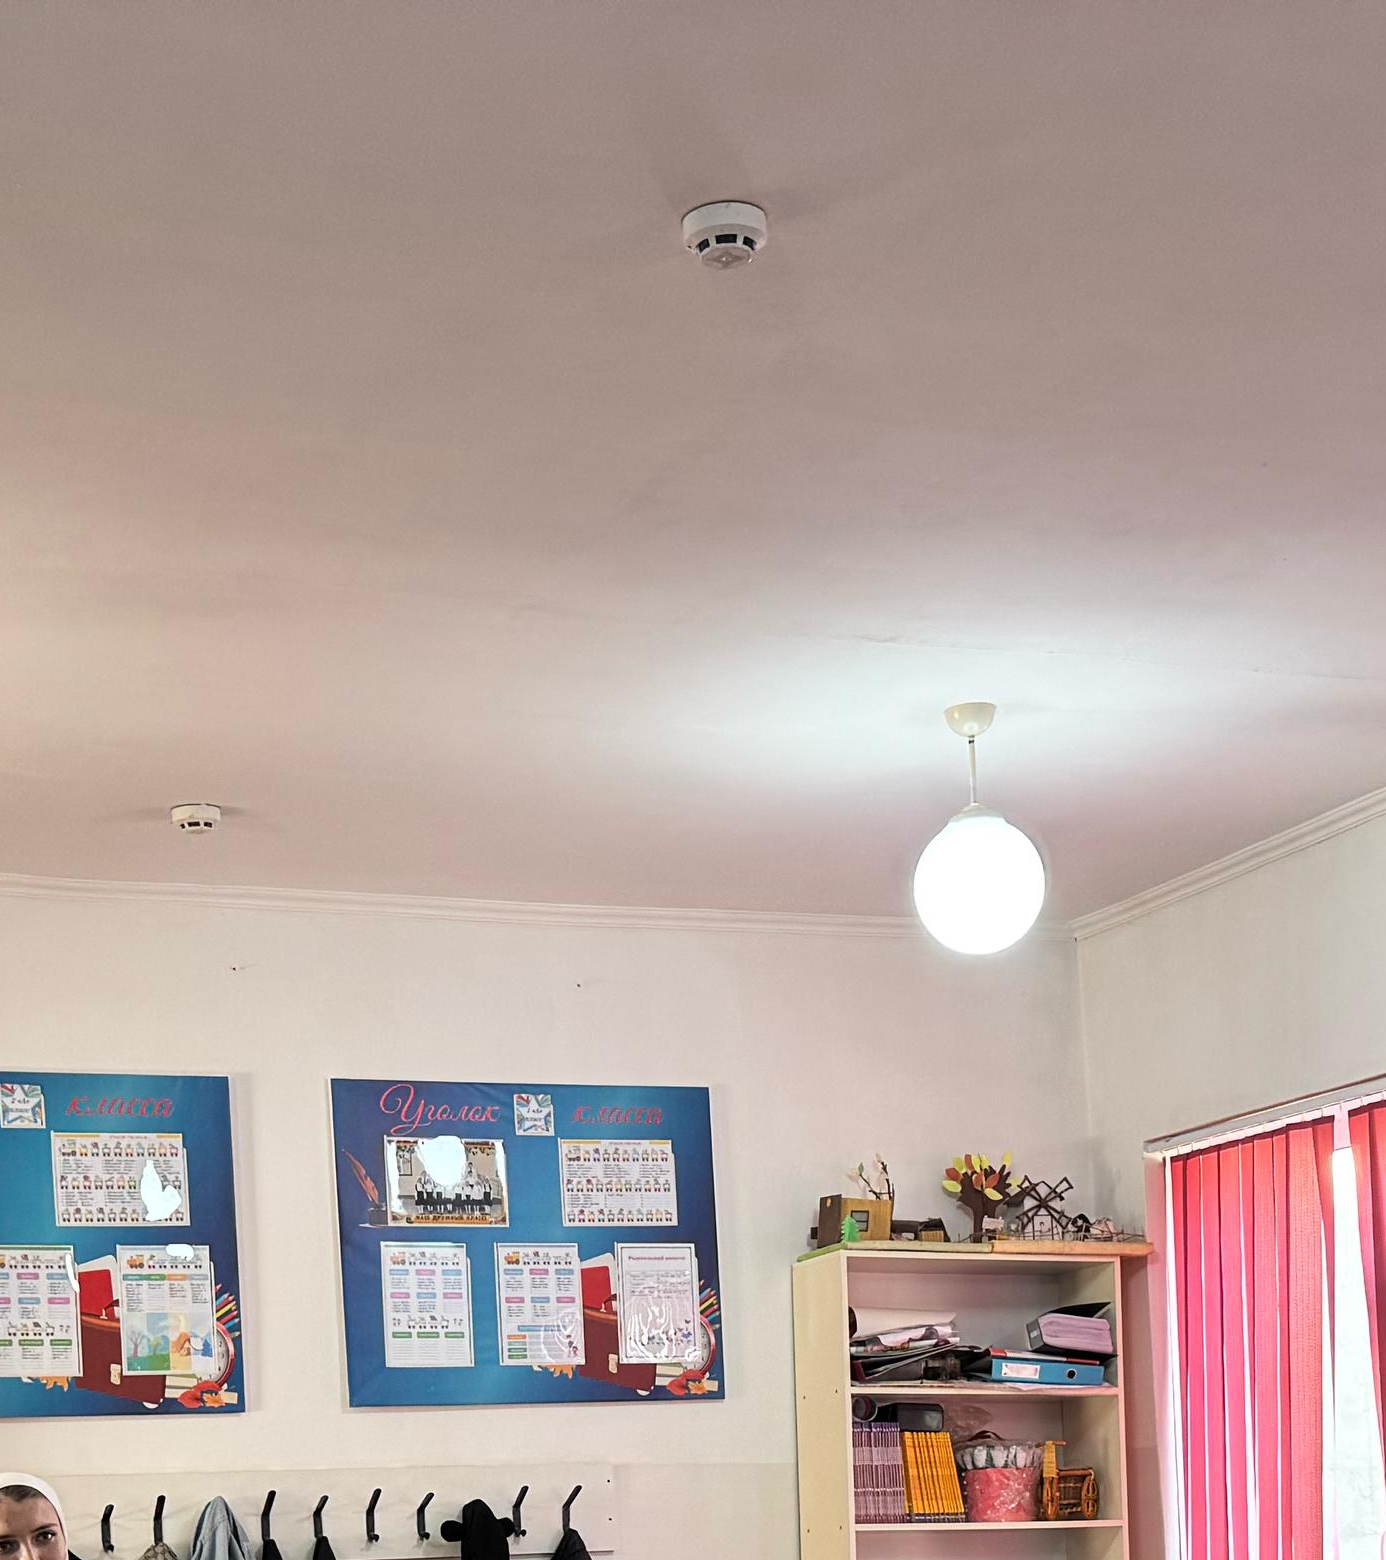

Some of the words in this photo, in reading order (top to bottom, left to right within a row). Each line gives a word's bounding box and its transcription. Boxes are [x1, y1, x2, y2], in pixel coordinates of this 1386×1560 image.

[66, 1095, 176, 1117] класса
[379, 1083, 501, 1135] Уголок
[570, 1105, 663, 1126] класса
